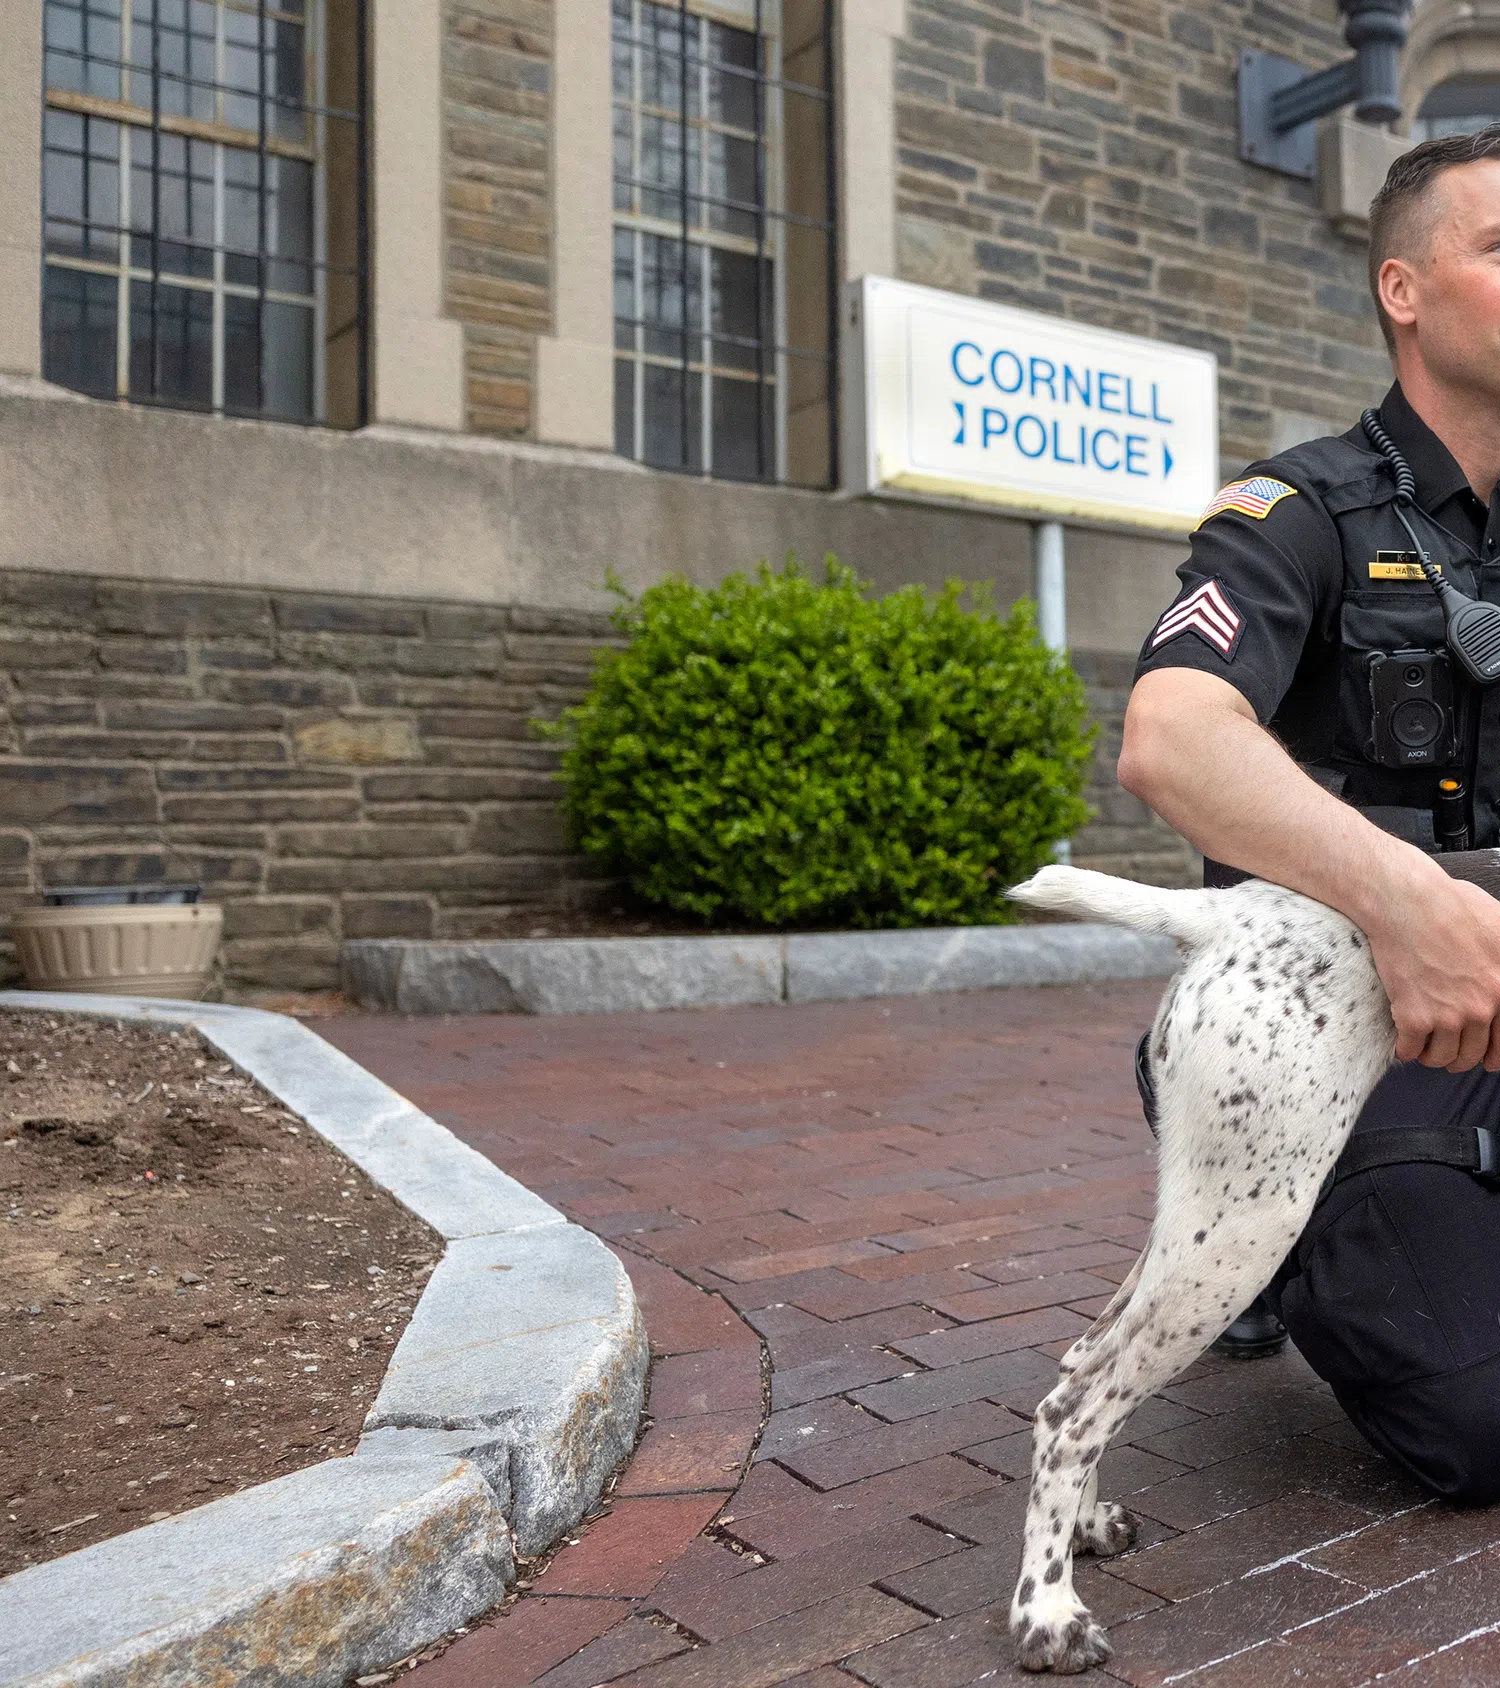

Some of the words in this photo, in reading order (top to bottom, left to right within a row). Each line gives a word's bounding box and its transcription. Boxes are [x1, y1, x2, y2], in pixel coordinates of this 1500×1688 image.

[951, 341, 1175, 425] CORNELL
[982, 407, 1150, 477] POLICE
[1407, 750, 1428, 758] AXON
